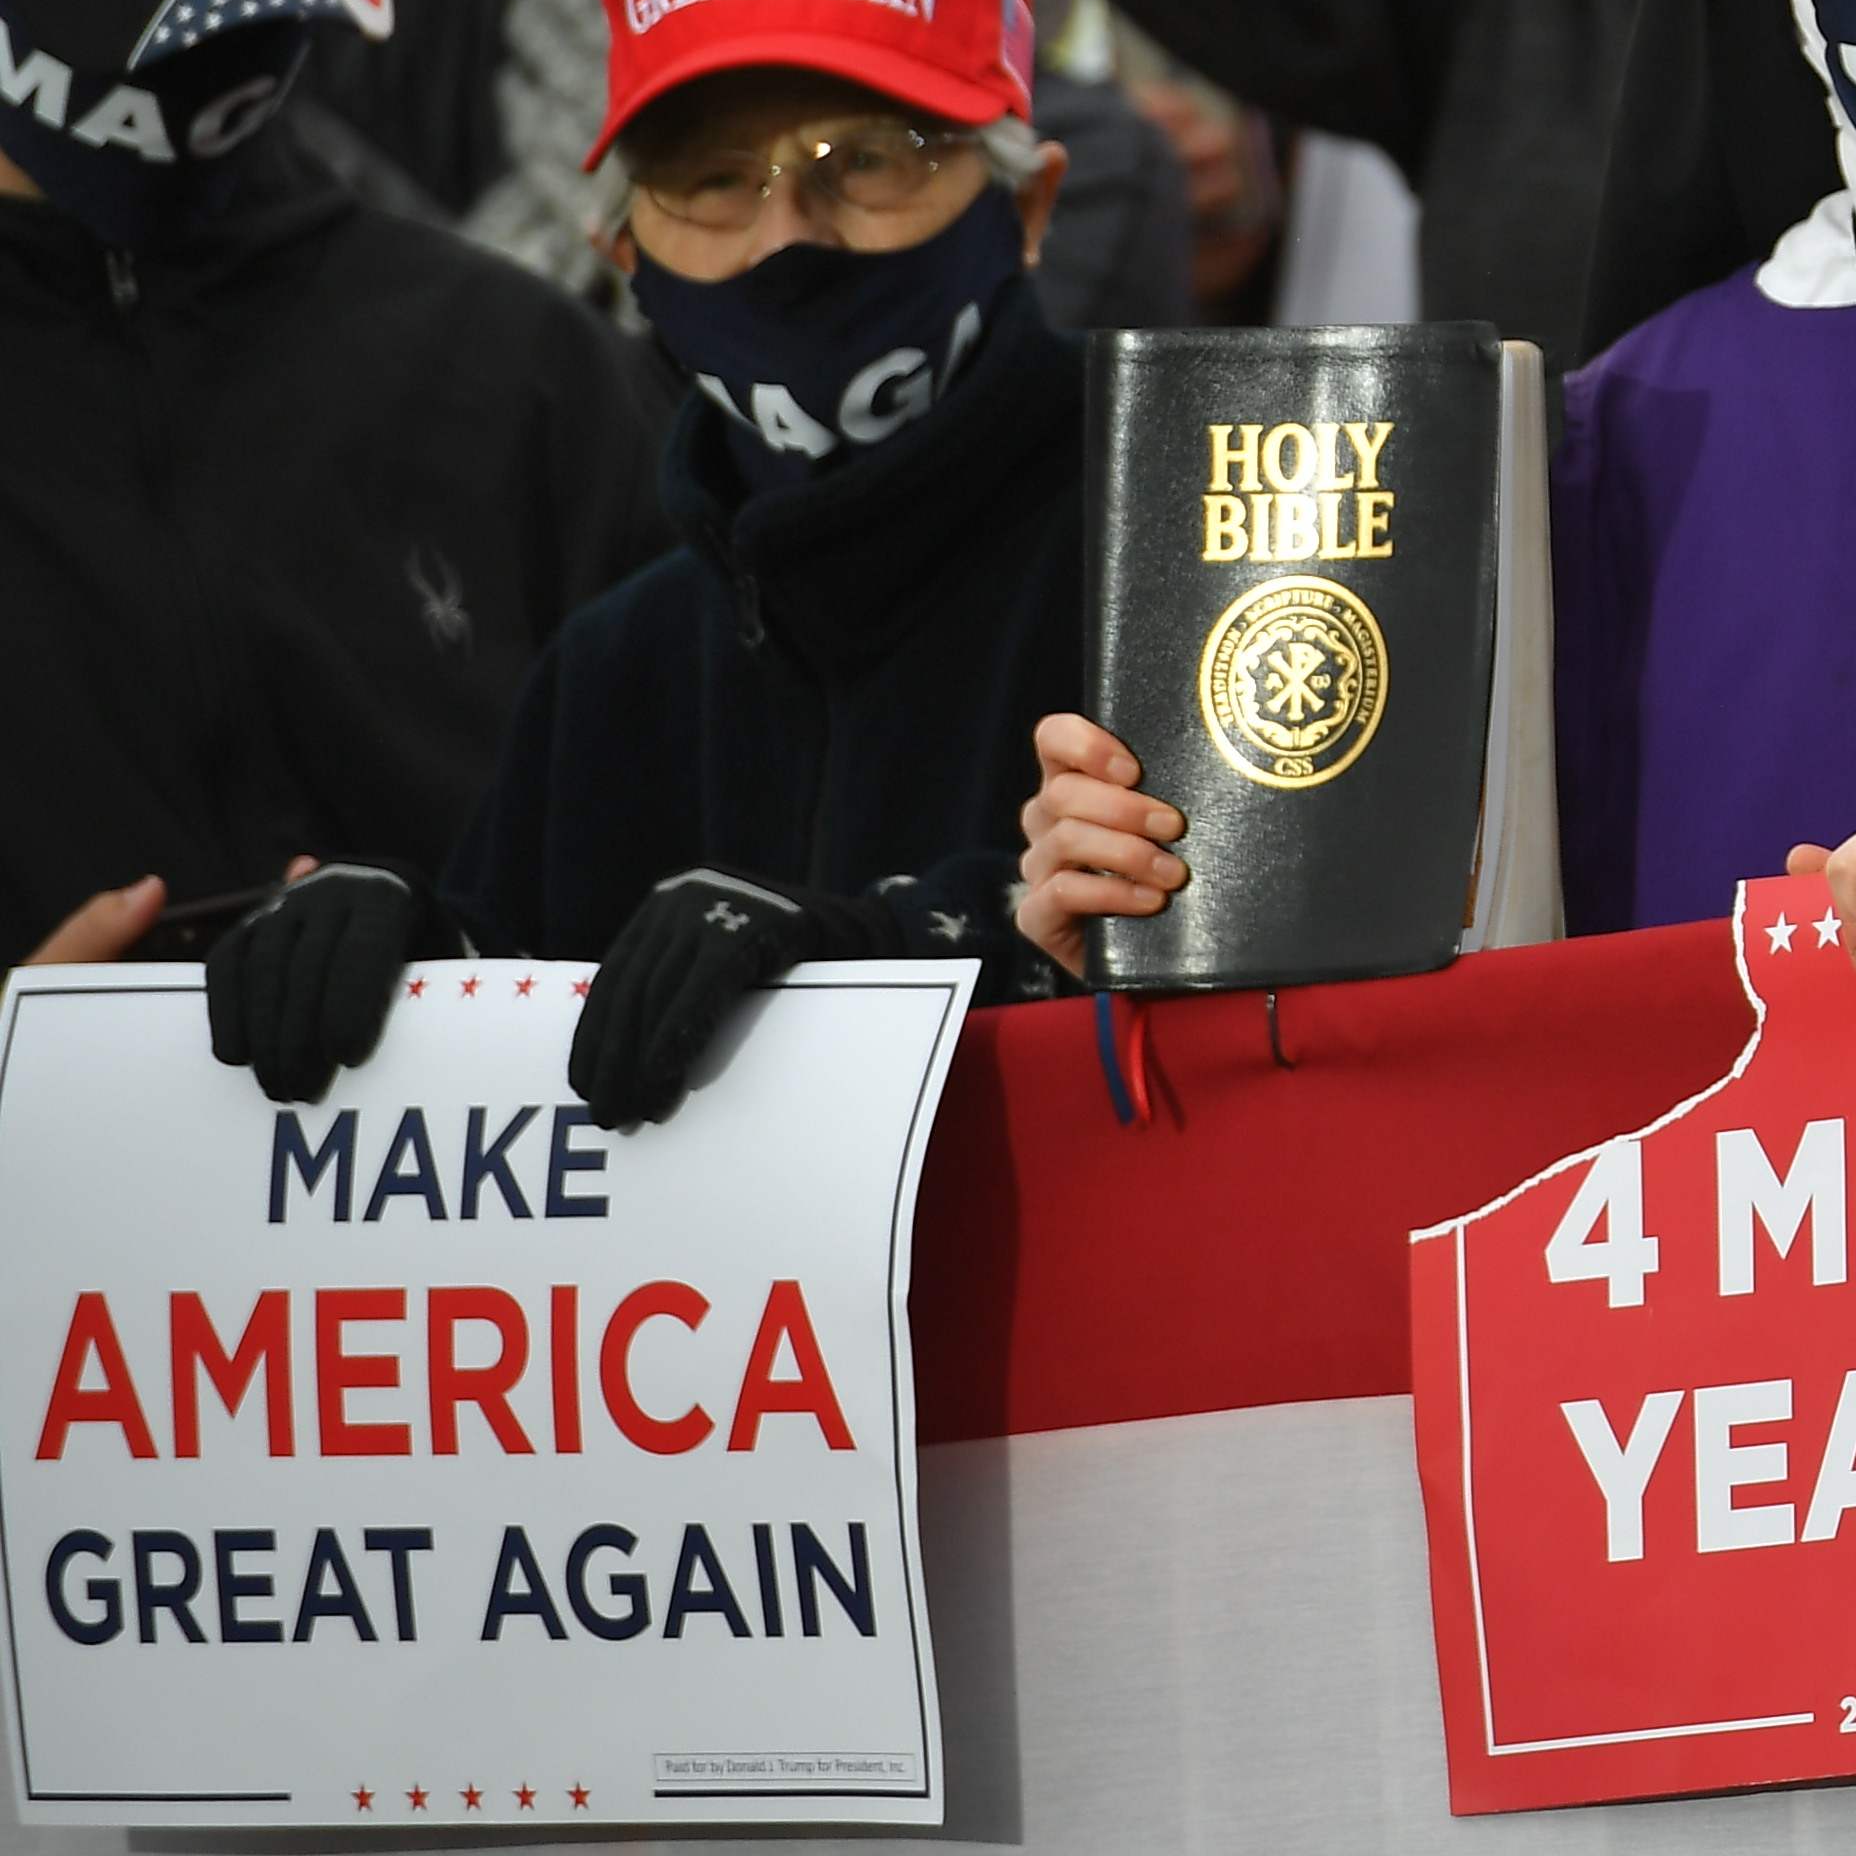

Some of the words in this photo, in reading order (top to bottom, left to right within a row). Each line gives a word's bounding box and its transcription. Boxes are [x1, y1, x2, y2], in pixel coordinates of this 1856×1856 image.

[1208, 421, 1396, 494] HOLY
[1201, 490, 1396, 563] BIBLE
[268, 1103, 611, 1224] MAKE
[1542, 1138, 1660, 1310] 4
[35, 1279, 858, 1461] AMERICA
[45, 1527, 434, 1647] GREAT
[480, 1520, 878, 1643] AGAIN
